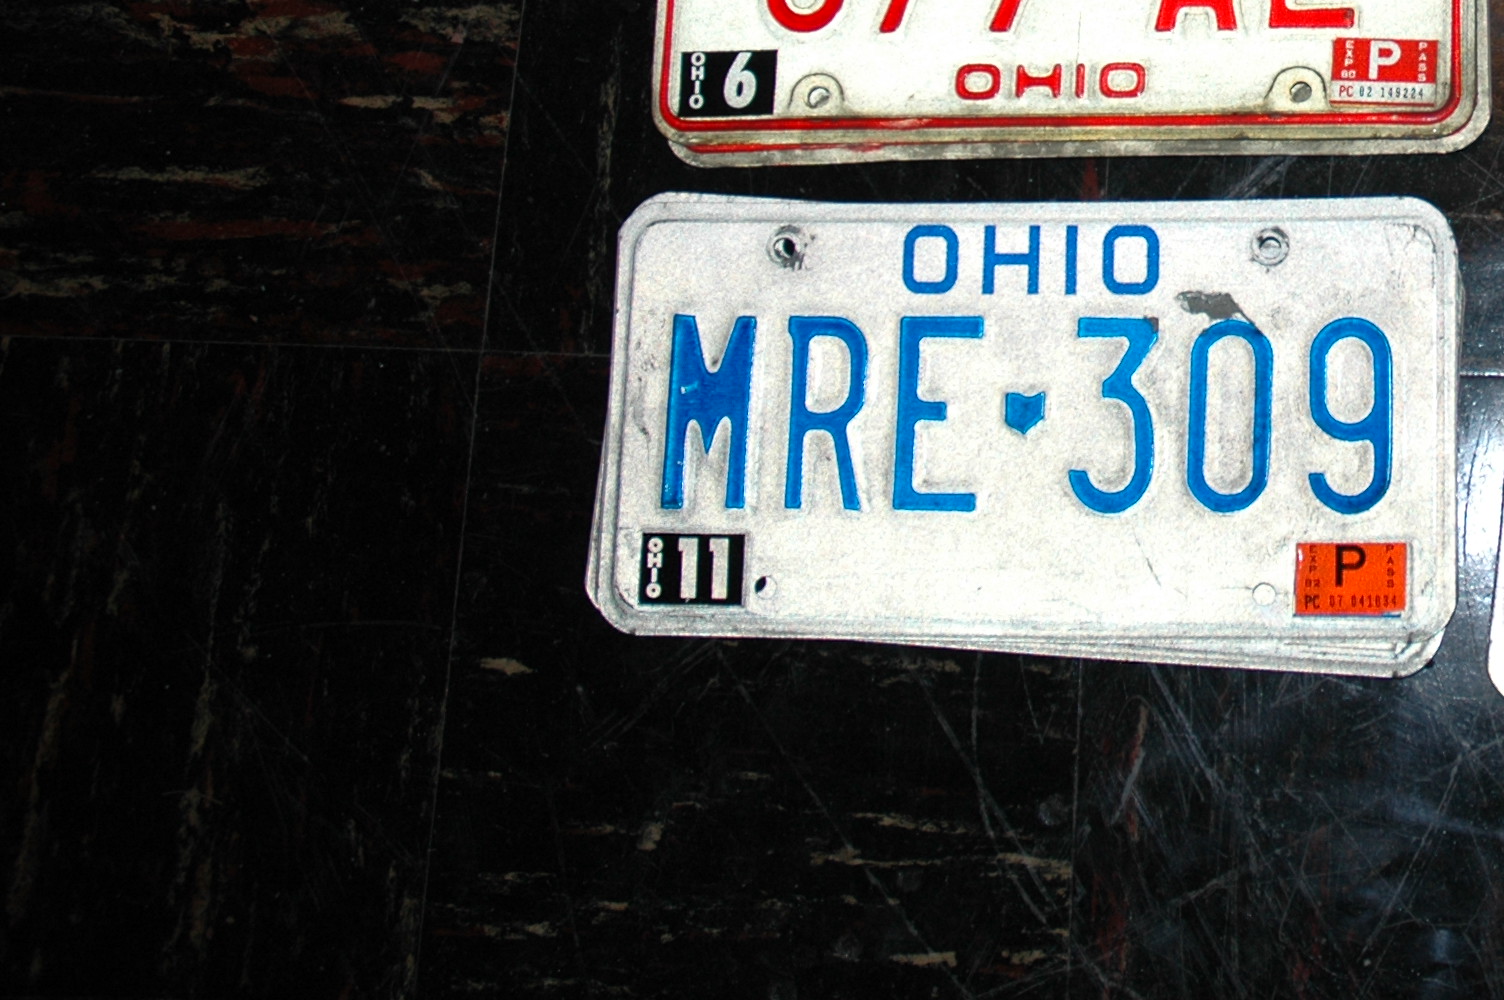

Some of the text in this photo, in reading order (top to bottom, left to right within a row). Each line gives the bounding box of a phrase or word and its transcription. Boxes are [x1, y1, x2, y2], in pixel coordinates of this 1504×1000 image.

[1344, 39, 1355, 67] EXP
[1368, 40, 1402, 80] P
[1417, 41, 1428, 83] PASS
[689, 51, 706, 110] OHIO
[723, 51, 753, 109] 6
[955, 63, 1146, 100] OHIO
[1339, 85, 1354, 98] PC
[1359, 86, 1373, 98] 02
[902, 224, 1161, 295] OHIO
[646, 537, 664, 599] OHIO
[678, 538, 729, 600] 11
[1335, 545, 1366, 587] P
[1305, 594, 1320, 609] PC
